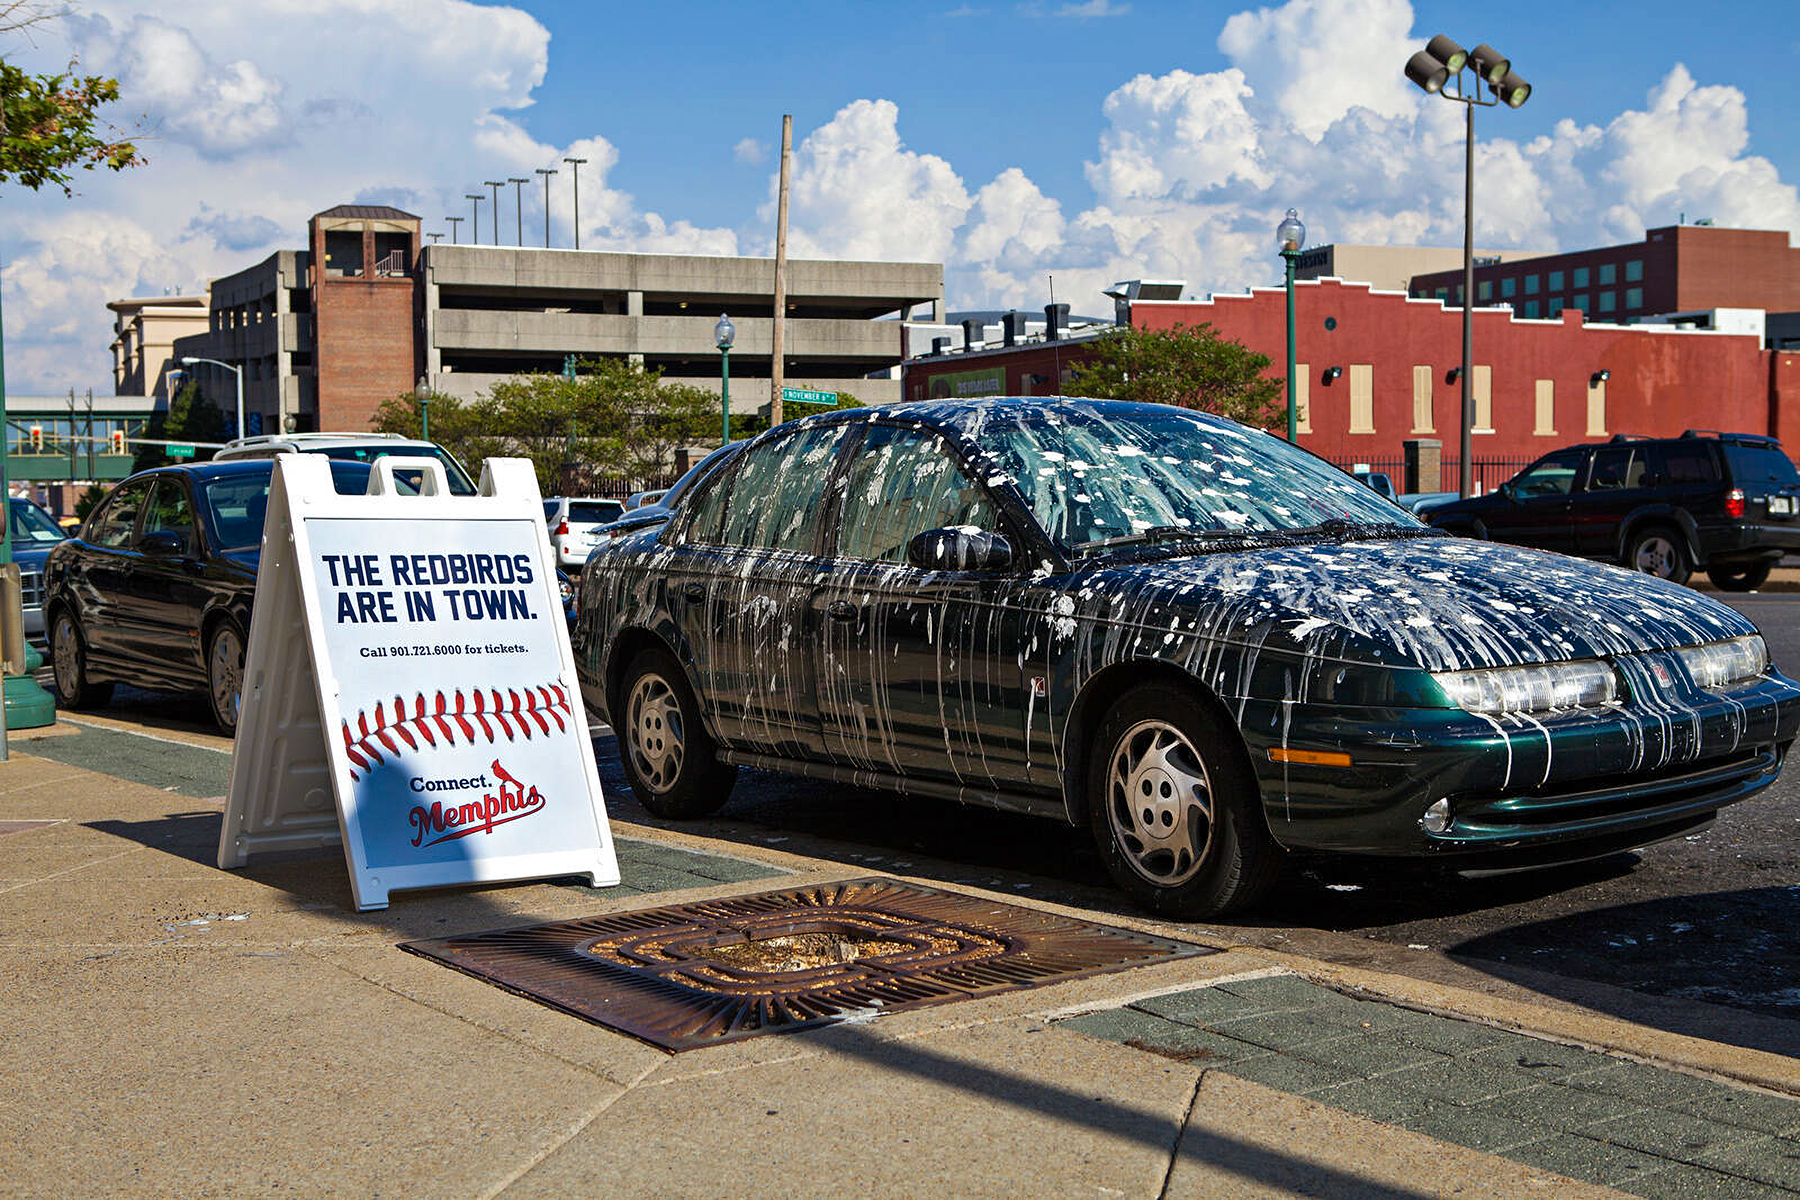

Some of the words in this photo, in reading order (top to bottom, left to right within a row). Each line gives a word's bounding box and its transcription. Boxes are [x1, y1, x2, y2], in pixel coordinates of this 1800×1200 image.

[322, 555, 383, 586] THE
[390, 553, 534, 586] REDBIRDS
[337, 591, 398, 623] ARE
[404, 590, 436, 622] IN
[443, 589, 538, 621] TOWN.
[359, 646, 388, 658] Call
[390, 644, 462, 657] 901.721.6000
[465, 644, 482, 655] for
[484, 643, 529, 655] tickets.
[409, 774, 493, 793] Connect.
[409, 784, 546, 847] Memphis
